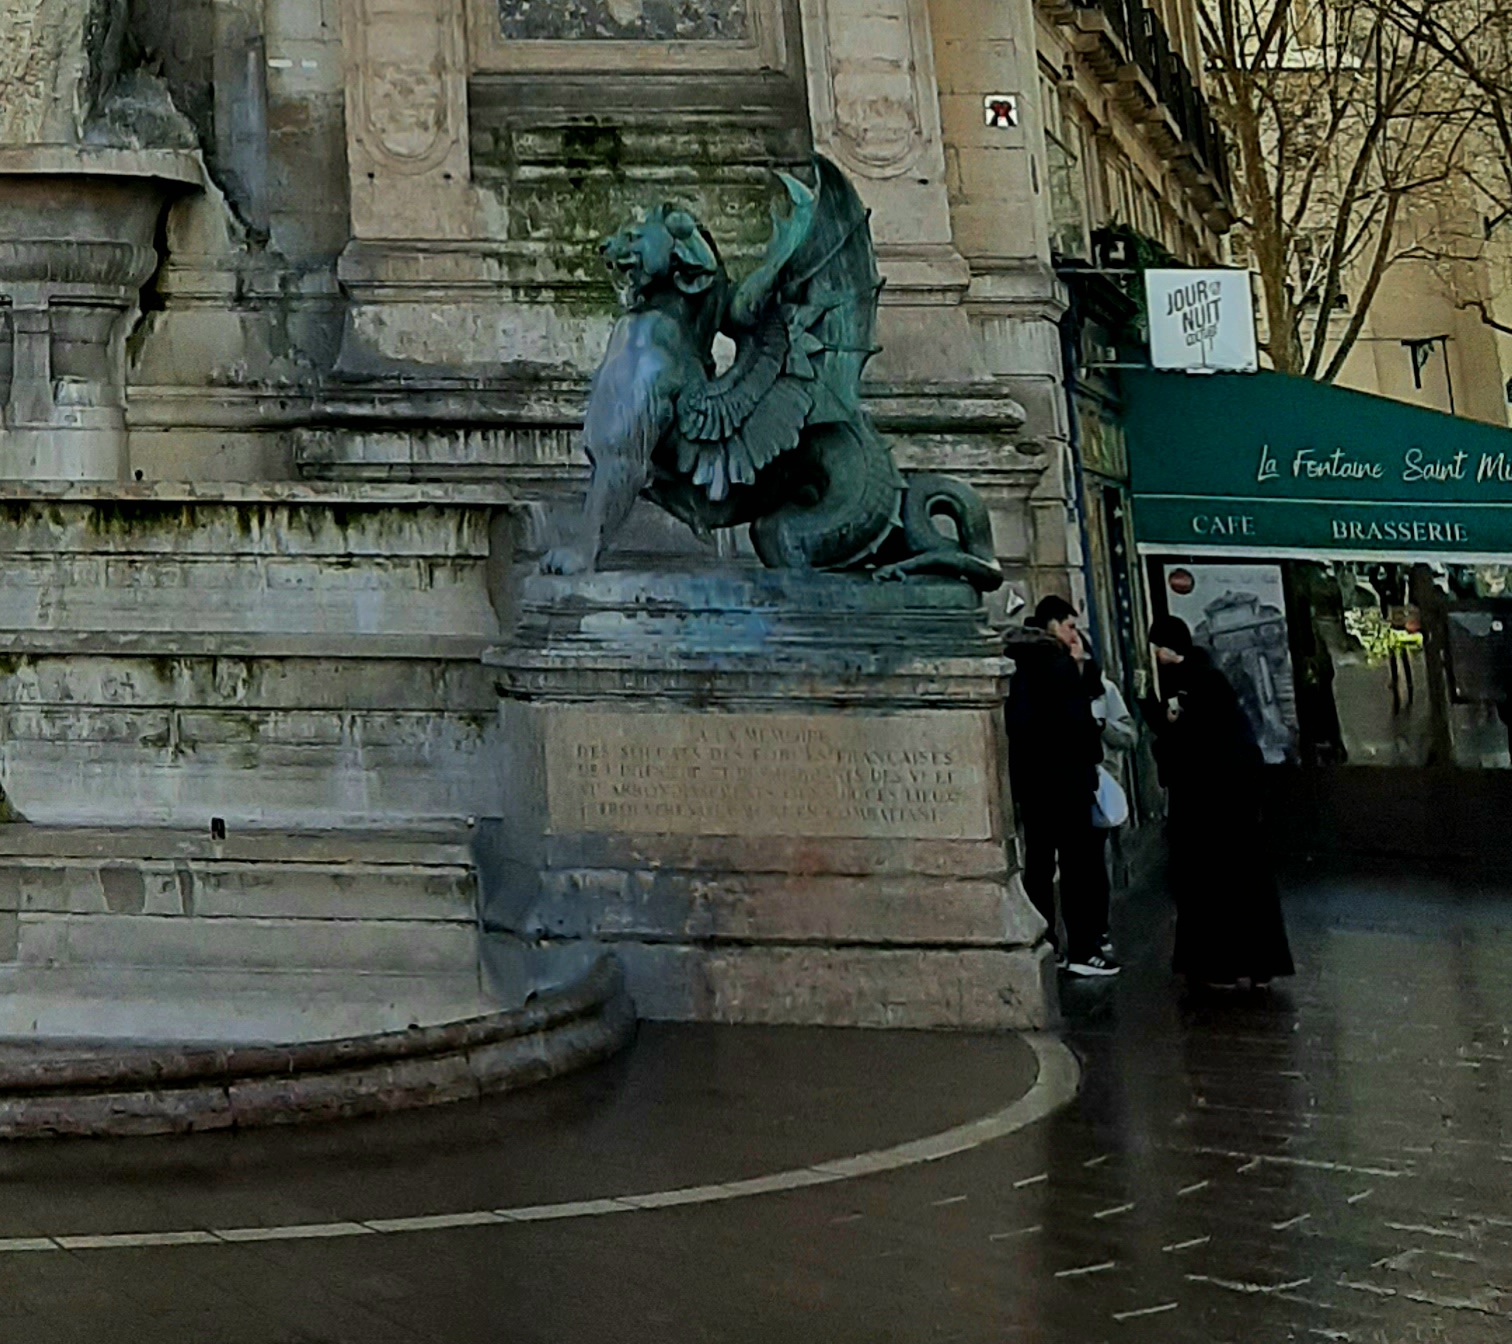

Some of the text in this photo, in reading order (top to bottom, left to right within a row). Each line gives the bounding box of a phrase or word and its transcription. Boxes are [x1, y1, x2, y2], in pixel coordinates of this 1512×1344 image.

[1166, 280, 1208, 316] JOUR
[1182, 297, 1222, 334] NUIT
[1257, 443, 1512, 483] La Fontaine Saint Mi
[1192, 514, 1469, 543] CAFE BRASSERIE
